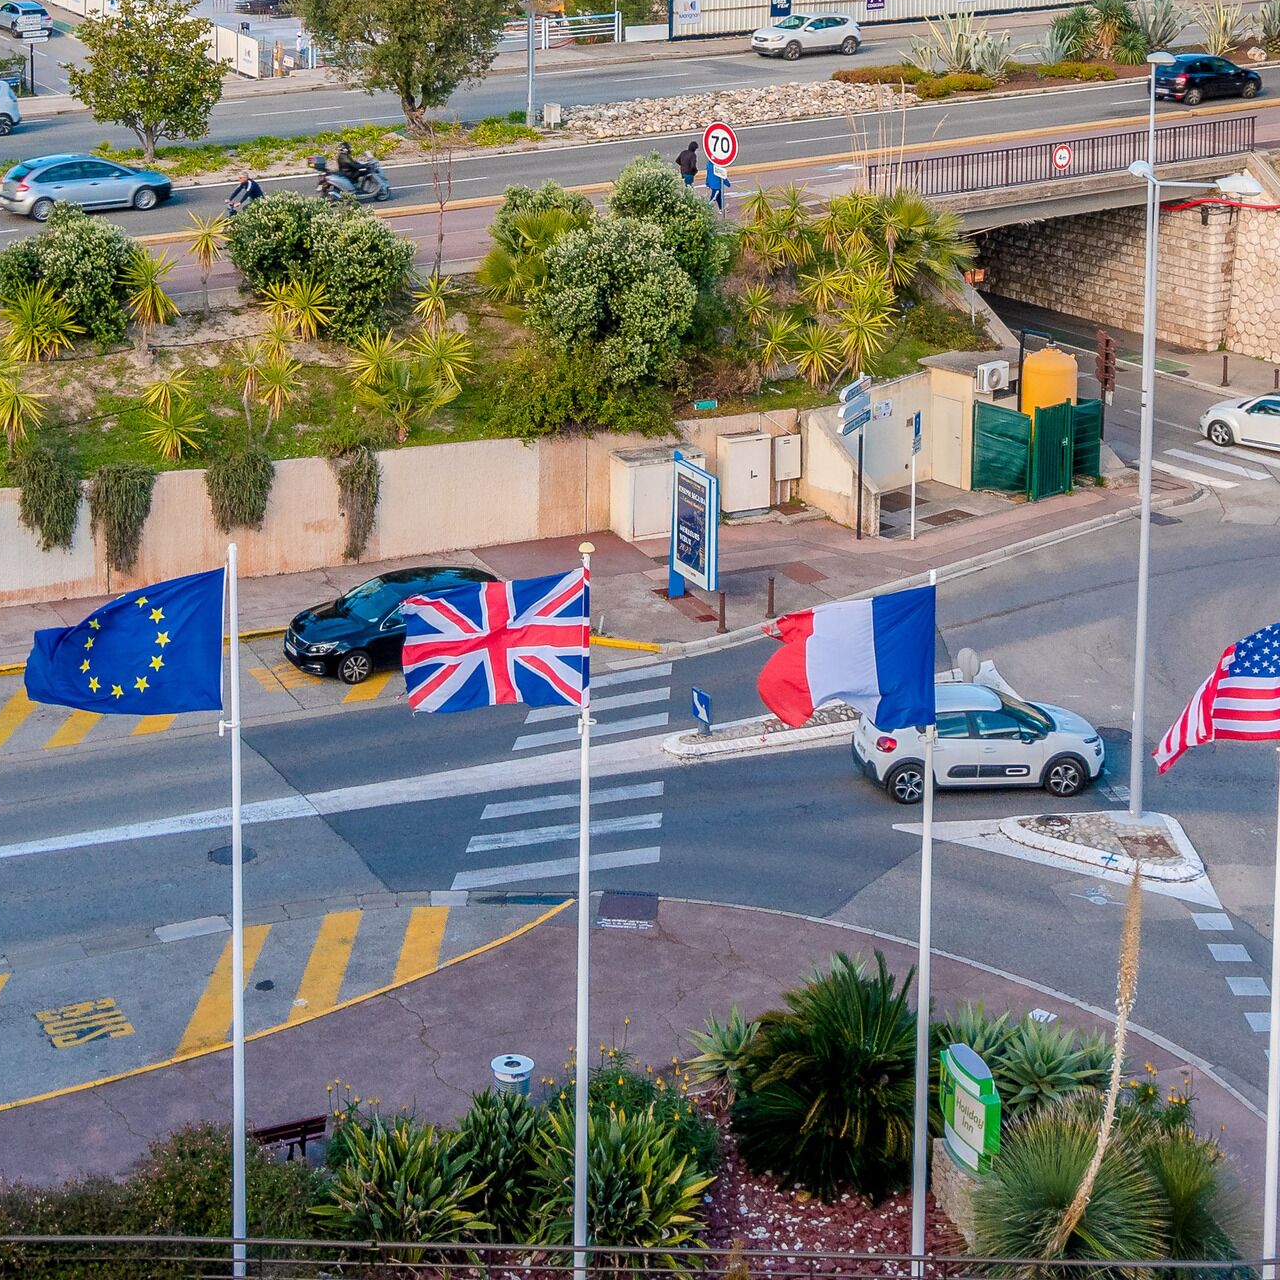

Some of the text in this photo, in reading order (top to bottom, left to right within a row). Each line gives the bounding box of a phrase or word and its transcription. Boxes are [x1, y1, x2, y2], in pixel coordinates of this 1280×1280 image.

[711, 135, 730, 154] 70
[35, 997, 136, 1049] BUS
[956, 1096, 985, 1130] Holiday
[961, 1115, 974, 1134] Inn
